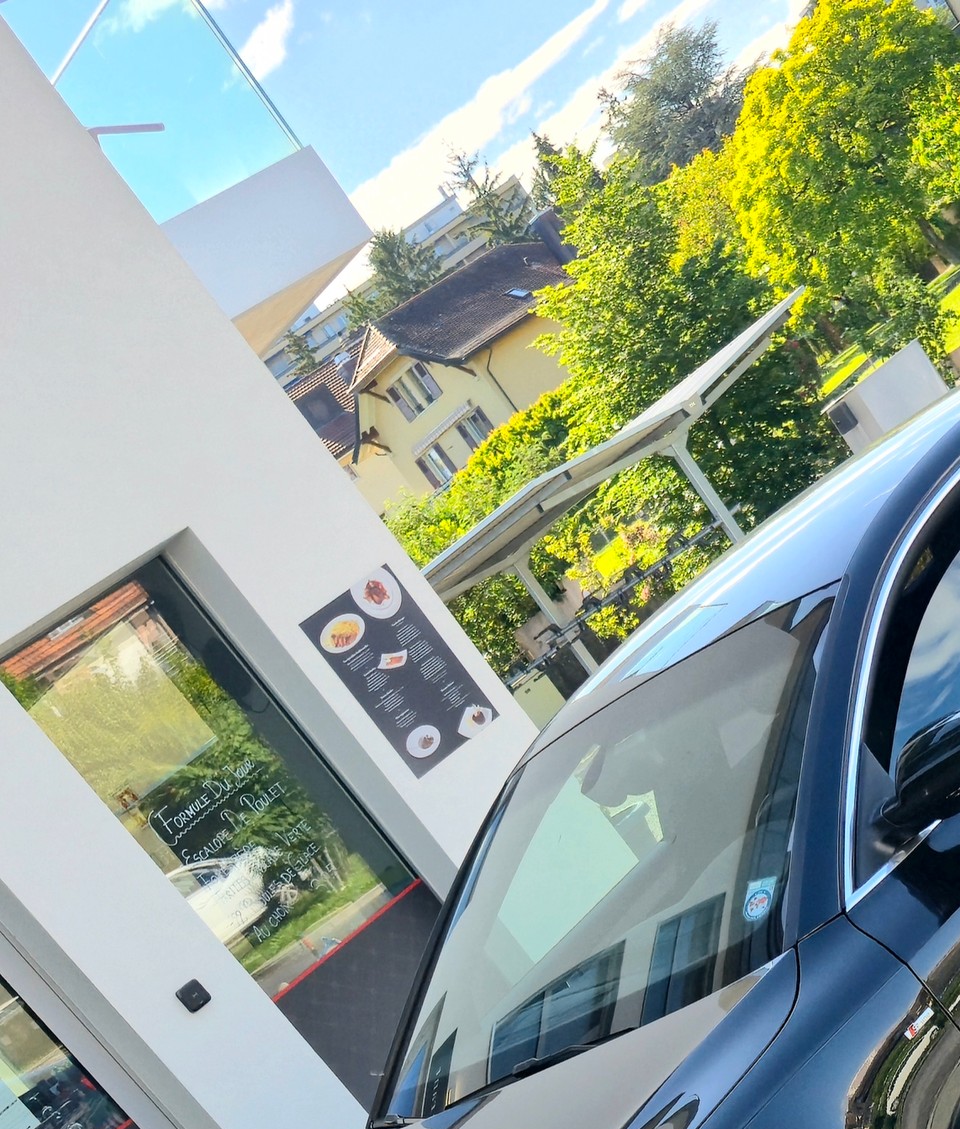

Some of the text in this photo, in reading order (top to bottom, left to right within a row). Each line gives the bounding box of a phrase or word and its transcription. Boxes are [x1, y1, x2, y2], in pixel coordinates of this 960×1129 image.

[240, 781, 286, 813] POULET
[275, 819, 312, 847] VERTE
[286, 843, 321, 873] GLACE
[252, 924, 271, 943] AU
